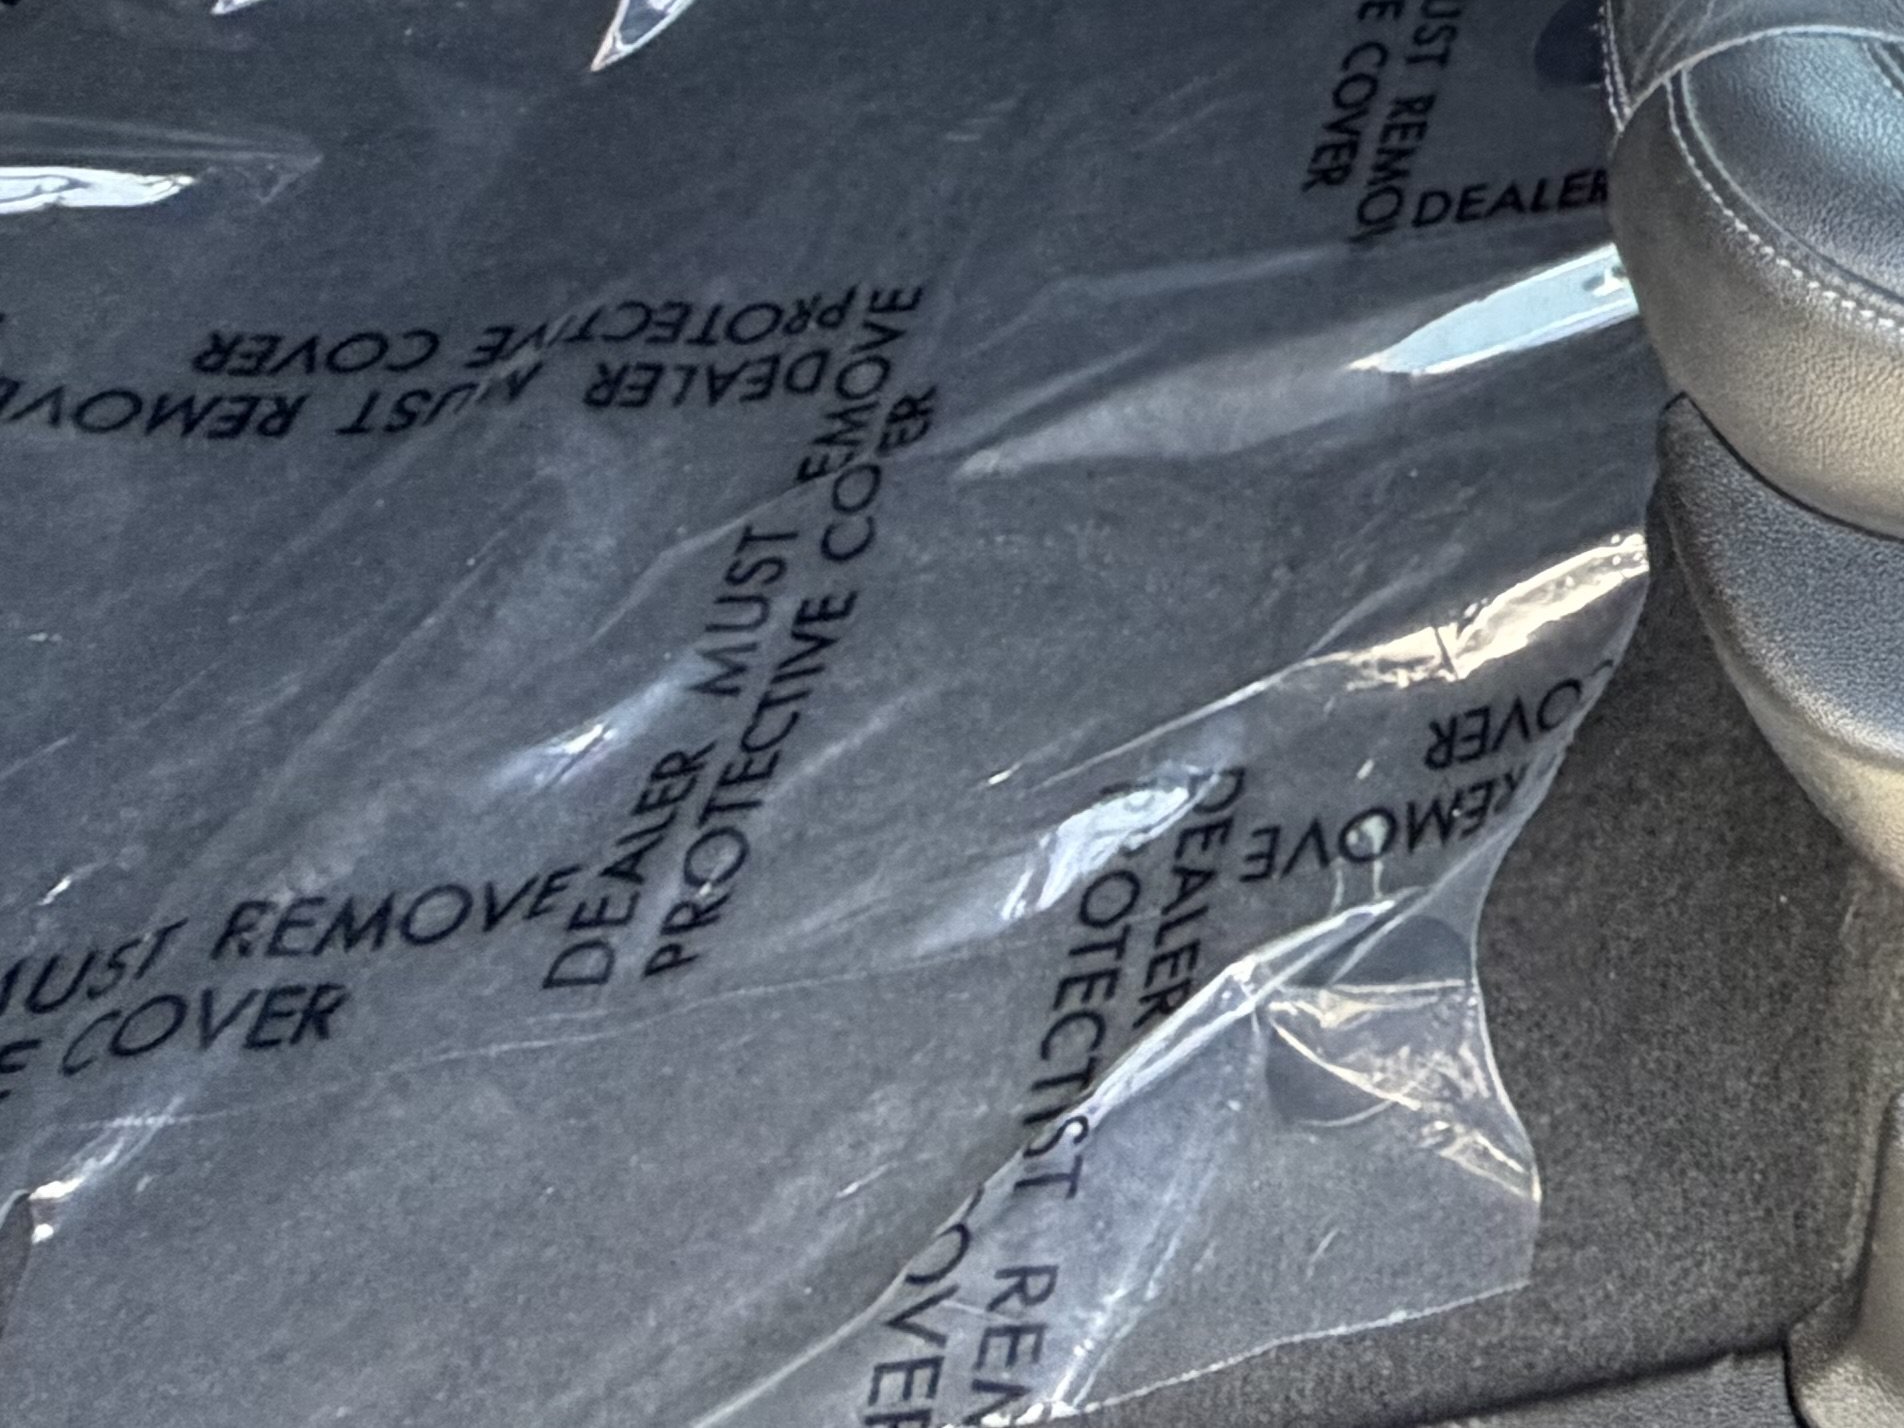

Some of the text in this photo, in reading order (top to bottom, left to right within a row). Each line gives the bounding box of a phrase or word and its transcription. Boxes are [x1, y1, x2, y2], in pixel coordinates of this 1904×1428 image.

[1302, 40, 1389, 192] COVER
[191, 284, 860, 377] PROTECTIVE COVER
[583, 348, 830, 409] DEALER
[541, 286, 925, 991] DEALER MUST EMOVE
[644, 385, 938, 978] PROTECTIVE COER
[1424, 658, 1615, 771] OVER
[211, 864, 584, 961] REMOVE
[1132, 766, 1246, 1030] DEALER
[59, 982, 349, 1077] COVER
